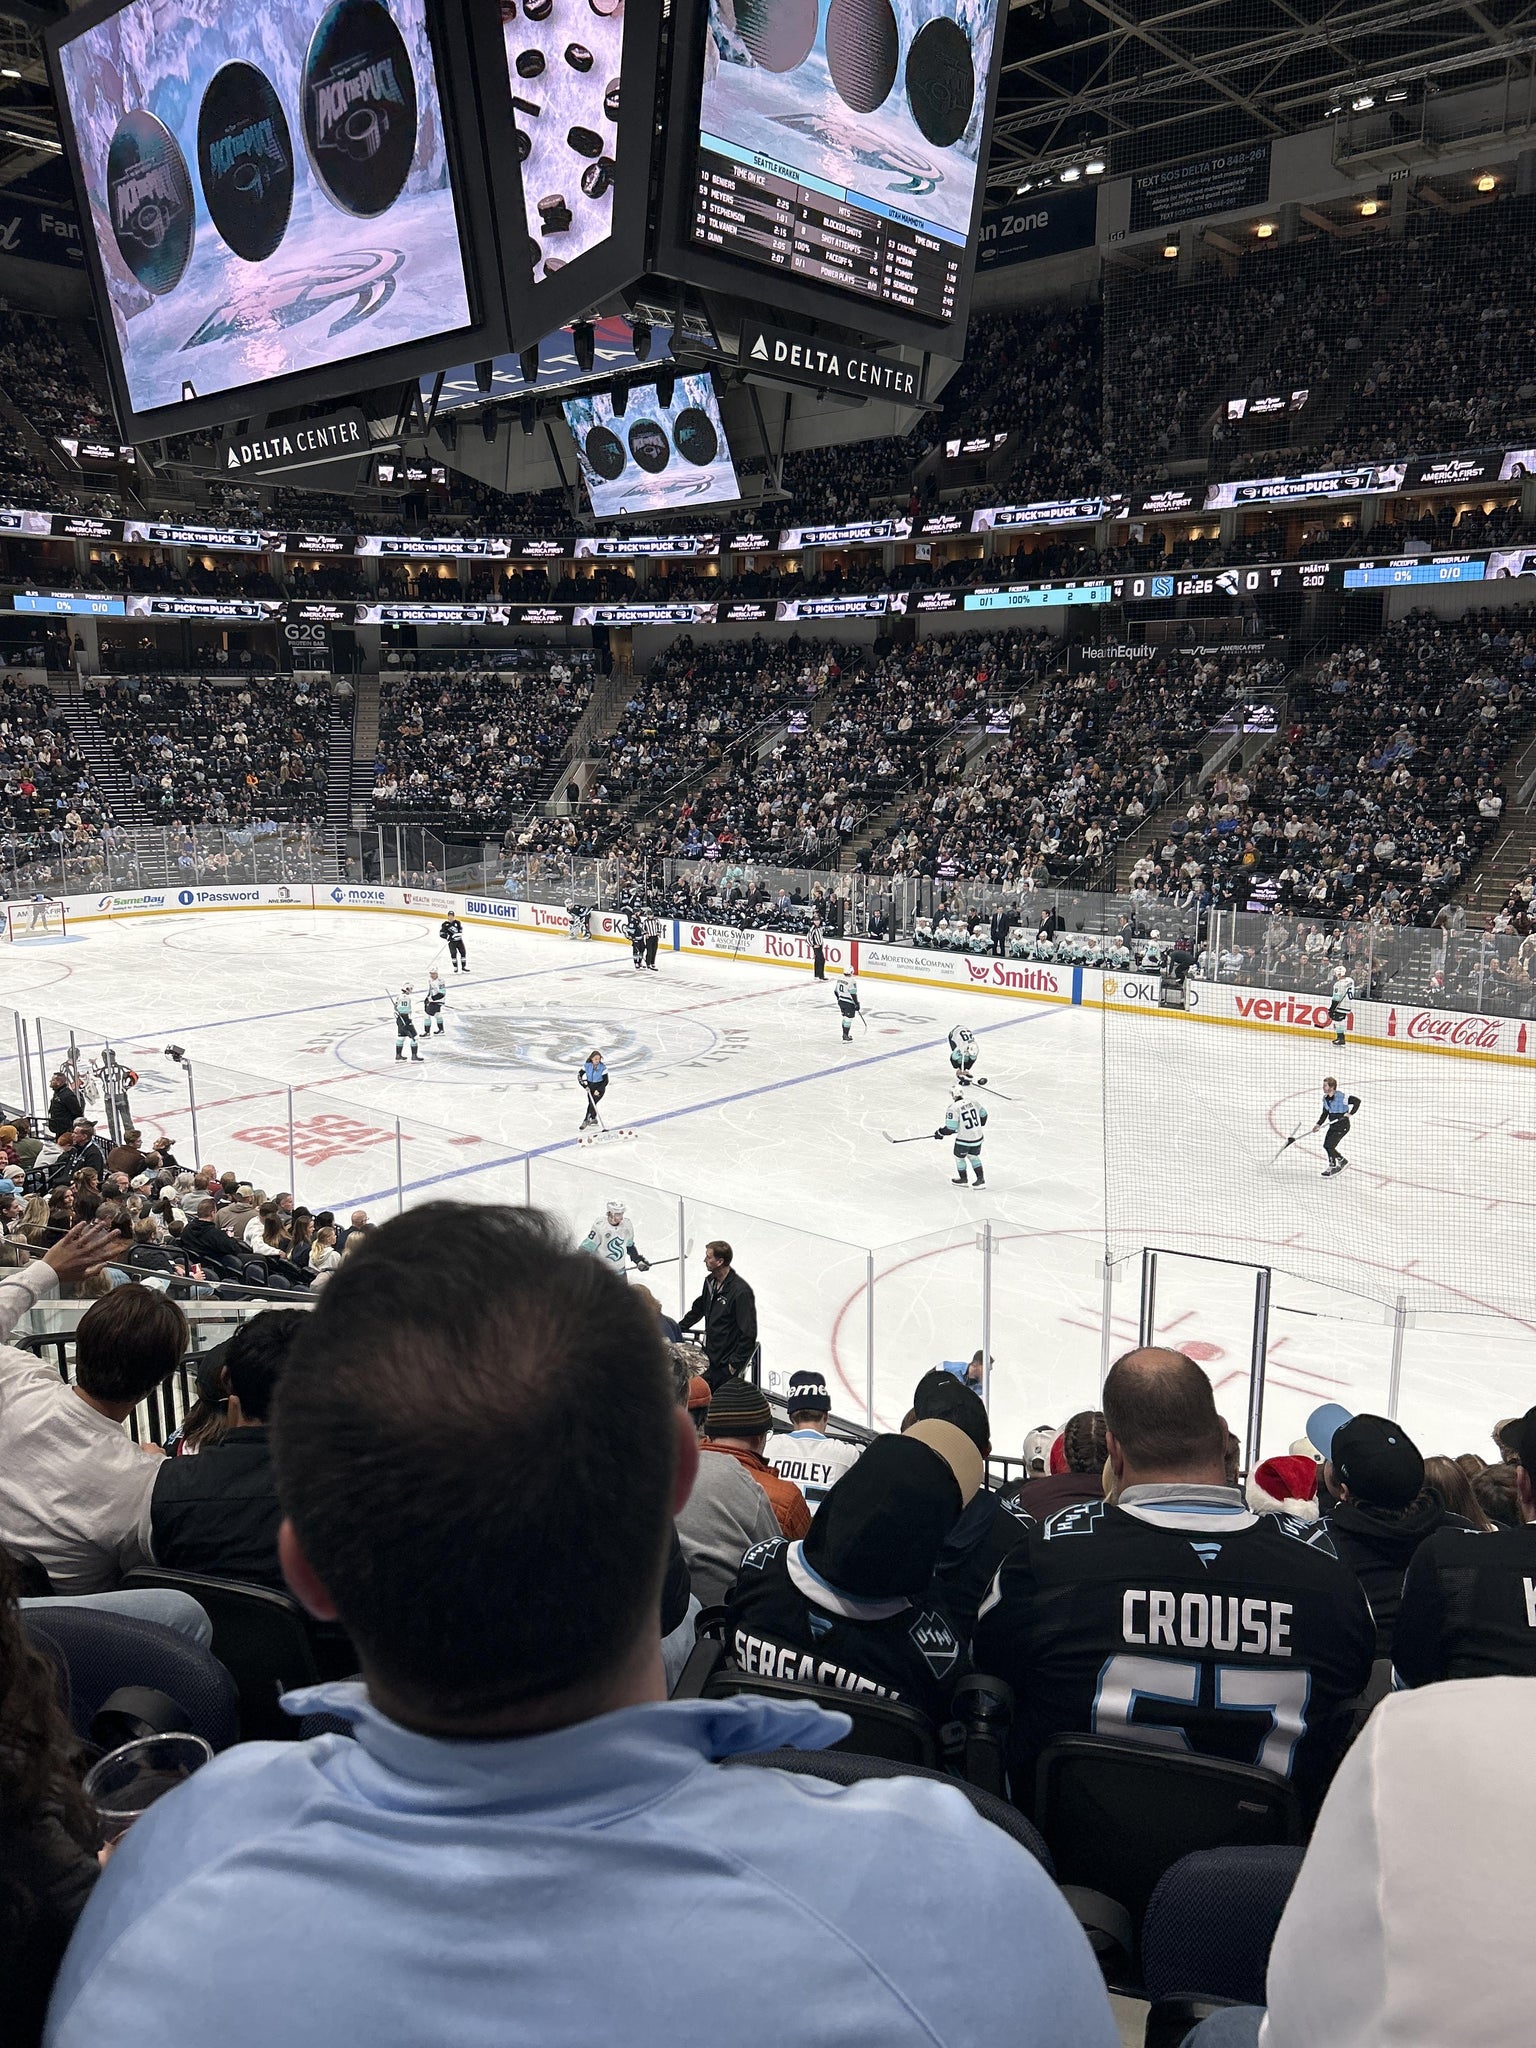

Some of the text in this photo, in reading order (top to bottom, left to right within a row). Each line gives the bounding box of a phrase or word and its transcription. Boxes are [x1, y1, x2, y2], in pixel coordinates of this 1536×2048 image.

[733, 166, 766, 186] TIME ON ICE
[754, 156, 800, 181] SEATTLE KRAKEN
[1137, 148, 1266, 188] TEXT SOS DELTA TO 848-261
[1391, 169, 1409, 182] HH
[701, 171, 789, 210] 10 BENIERS 2:25
[699, 185, 788, 223] 59 MEYERS 1:01
[805, 192, 809, 201] 2
[839, 207, 850, 217] HITS
[40, 214, 80, 240] Fan
[702, 201, 787, 237] 9 STEPHENSON 2:15
[803, 210, 807, 218] 2
[823, 217, 845, 232] BLOCKED
[846, 226, 862, 238] SHOTS
[889, 210, 924, 229] UTAH MAMMOTH
[978, 211, 1048, 242] an Zone
[697, 214, 785, 251] 20 TOLVANEN 2:05
[1110, 231, 1124, 242] GG
[696, 228, 784, 264] 29 DUNN 2:07
[795, 241, 810, 253] 100%
[826, 252, 847, 265] FACEOFF
[822, 234, 834, 245] SHOT
[835, 239, 861, 254] ATTEMPTS
[874, 252, 878, 260] 3
[795, 258, 805, 268] 0/1
[821, 267, 838, 278] POWER
[839, 273, 855, 284] PLAYS
[774, 340, 913, 394] DELTA CENTER
[241, 422, 360, 463] DELTA CENTER
[1420, 468, 1484, 482] AMERICA FIRST
[1262, 485, 1289, 496] PICK
[1306, 480, 1338, 492] PUCK
[1016, 511, 1037, 521] PICK
[1051, 507, 1076, 518] PUCK
[1142, 501, 1171, 510] AMERICA
[1172, 498, 1192, 506] FIRST
[172, 532, 193, 541] PICK
[208, 534, 235, 544] PUCK
[819, 532, 838, 541] PICK
[850, 527, 870, 538] PUCK
[403, 543, 424, 552] PICK
[438, 543, 463, 552] PUCK
[1390, 559, 1418, 567] FACEOFFS
[1246, 572, 1278, 589] 0 1
[1303, 575, 1324, 586] 2:00
[1364, 567, 1460, 583] 1 0% 0/0
[980, 588, 1121, 606] 0/1 100% 2 2 8 4
[1134, 580, 1144, 596] 0
[1177, 580, 1213, 594] 12:26
[285, 624, 325, 640] G2G
[1082, 644, 1156, 660] HealthEquity
[1247, 643, 1265, 651] FIRST
[113, 896, 165, 905] SameDay
[197, 891, 259, 902] 1Password
[349, 890, 385, 900] moxie
[468, 902, 516, 917] BUD LIGHT
[707, 926, 755, 940] CRAIG SWAPP
[716, 936, 750, 948] ASSOCIATES
[765, 934, 841, 963] RioTito
[881, 954, 913, 964] MORETON
[915, 958, 920, 966] &
[921, 958, 954, 969] COMPANY
[993, 962, 1058, 993] Smith's
[1124, 982, 1198, 1006] OKLD
[1408, 1012, 1504, 1048] Coca-Cola
[490, 1071, 669, 1092] CETER
[961, 1109, 979, 1130] 59
[286, 1114, 416, 1146] SEAT
[232, 1126, 364, 1167] GEEK
[1123, 1590, 1294, 1657] CROUSE
[915, 1627, 952, 1647] UTAH
[736, 1629, 900, 1700] SERGACH
[1092, 1654, 1311, 1779] 67
